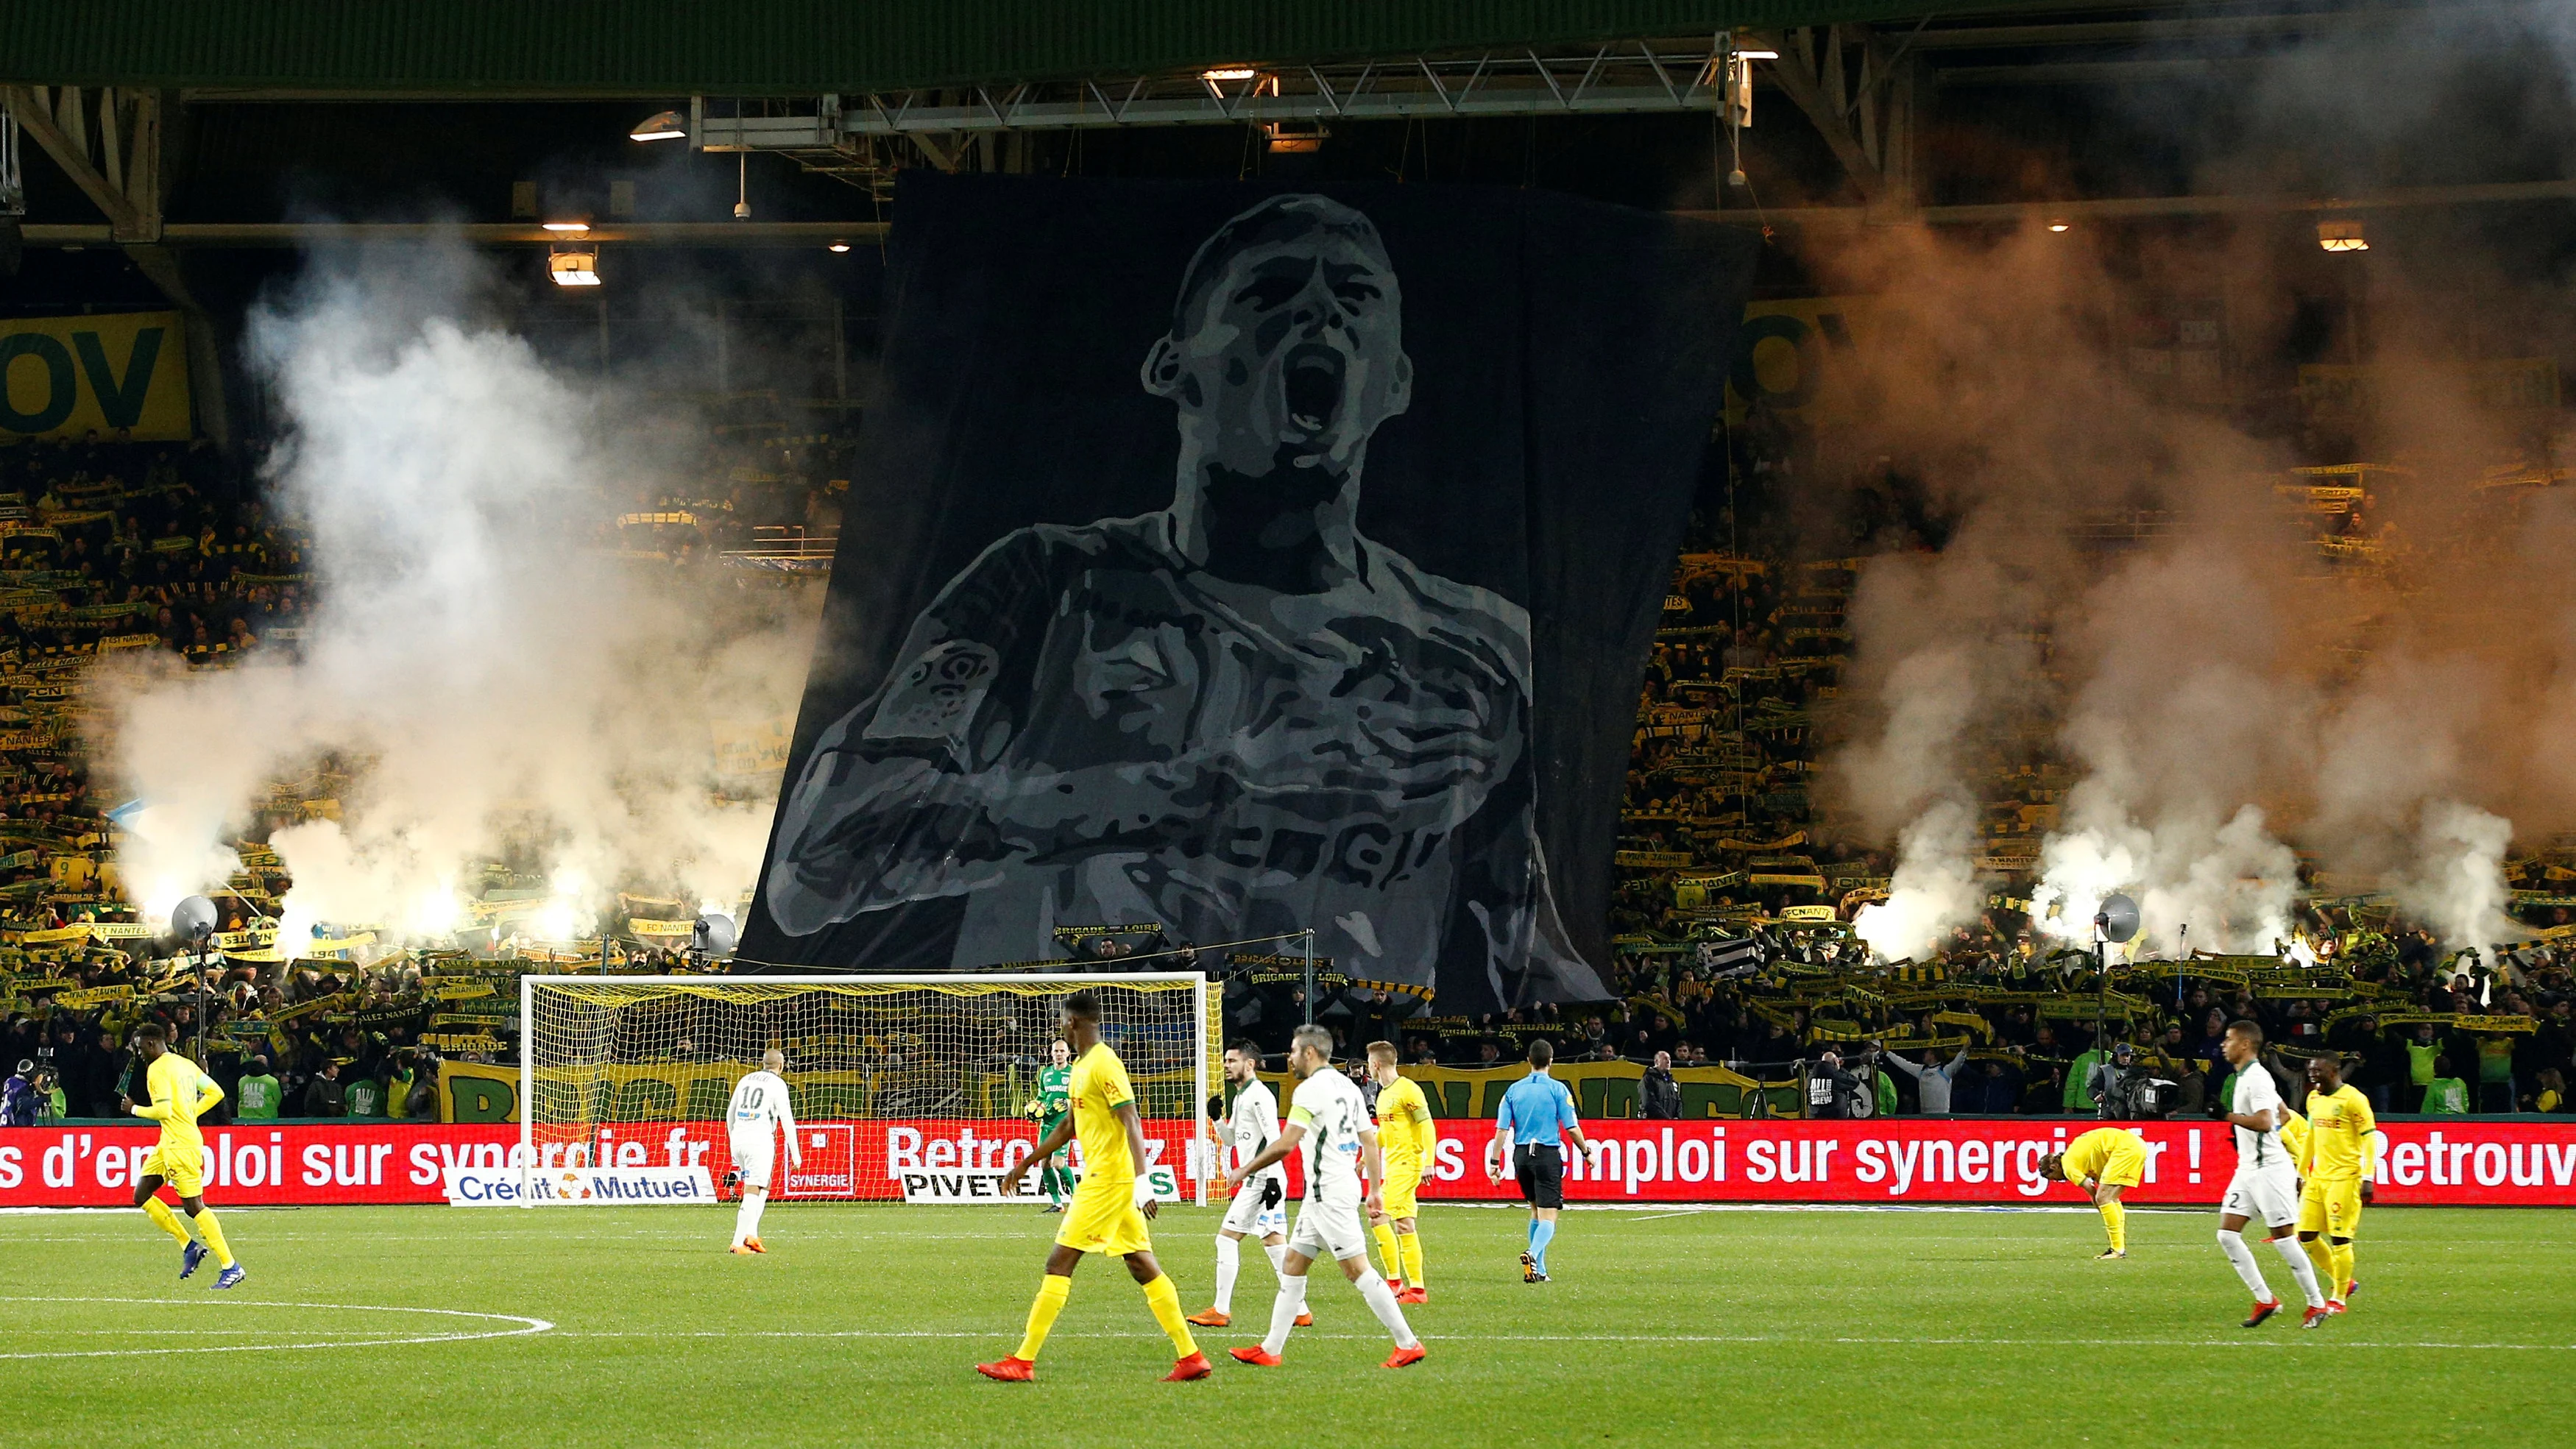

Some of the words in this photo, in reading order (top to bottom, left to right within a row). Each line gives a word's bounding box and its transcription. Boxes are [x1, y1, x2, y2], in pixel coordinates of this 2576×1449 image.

[60, 862, 68, 875] 9
[110, 927, 147, 935] NANTES
[647, 924, 658, 932] FC
[1055, 926, 1106, 936] BRIGADE
[1123, 924, 1158, 933] LOIRE
[442, 960, 474, 968] ALLEZ
[1250, 973, 1301, 986] BRIGADE
[385, 1007, 425, 1020] NANTES
[2463, 1017, 2486, 1025] MUR
[439, 1041, 508, 1052] BRIGADE
[740, 1085, 764, 1110] 10
[1746, 1141, 1839, 1183] sur
[2187, 1129, 2201, 1183] !
[301, 1143, 392, 1187] sur
[593, 1175, 697, 1200] Mutuel
[790, 1174, 849, 1188] SYNERGIE
[2229, 1192, 2240, 1208] 2
